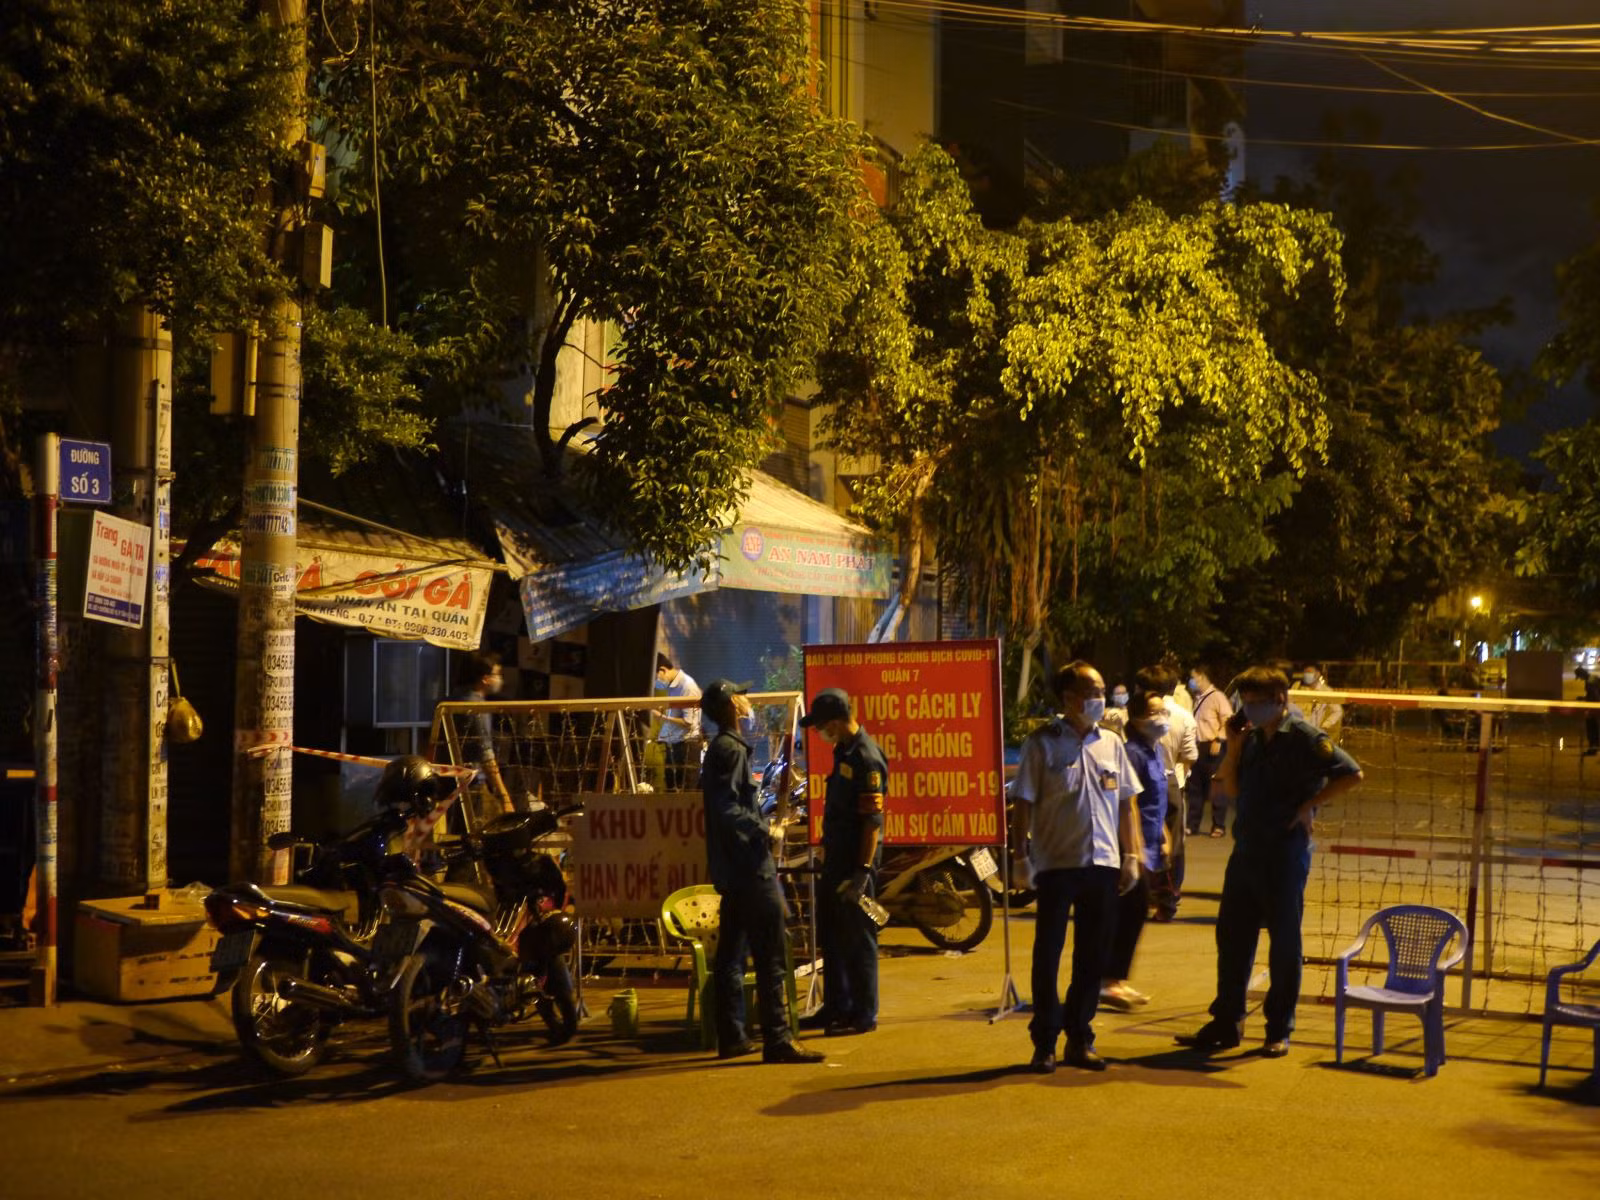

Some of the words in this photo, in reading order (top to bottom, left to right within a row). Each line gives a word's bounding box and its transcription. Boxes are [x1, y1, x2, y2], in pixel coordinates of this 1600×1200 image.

[70, 448, 100, 465] ĐƯỜNG
[71, 472, 89, 494] SỐ
[92, 478, 100, 495] 3
[96, 519, 119, 546] Trang
[795, 548, 833, 568] NAM
[423, 572, 472, 610] GÀ
[402, 604, 427, 621] TẠI
[432, 608, 469, 626] QUÁN
[912, 669, 920, 682] 7
[864, 691, 900, 726] VỰC
[906, 688, 958, 720] CÁCH
[962, 692, 982, 719] LY
[908, 723, 973, 759] CHỐNG
[914, 770, 999, 797] COVID-19
[589, 808, 647, 840] KHU
[909, 811, 930, 842] SỰ
[932, 805, 966, 836] CẤM
[969, 808, 998, 836] VÀO
